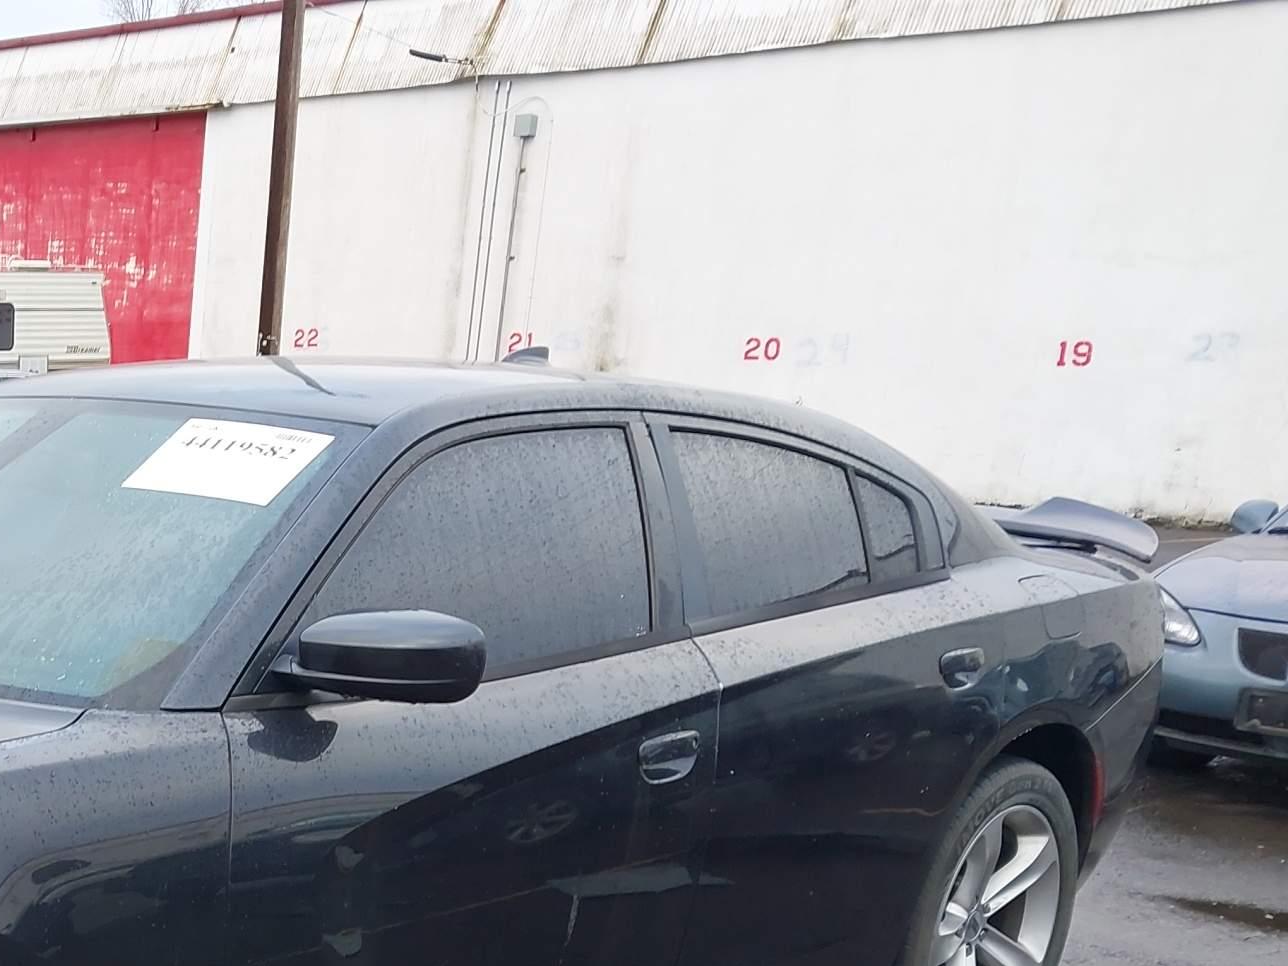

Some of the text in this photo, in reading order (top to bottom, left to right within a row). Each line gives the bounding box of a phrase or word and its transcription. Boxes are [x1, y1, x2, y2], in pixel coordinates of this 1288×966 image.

[294, 329, 319, 347] 22
[508, 332, 534, 353] 21
[744, 337, 781, 361] 20
[1057, 341, 1094, 366] 19
[181, 436, 296, 459] 44119582
